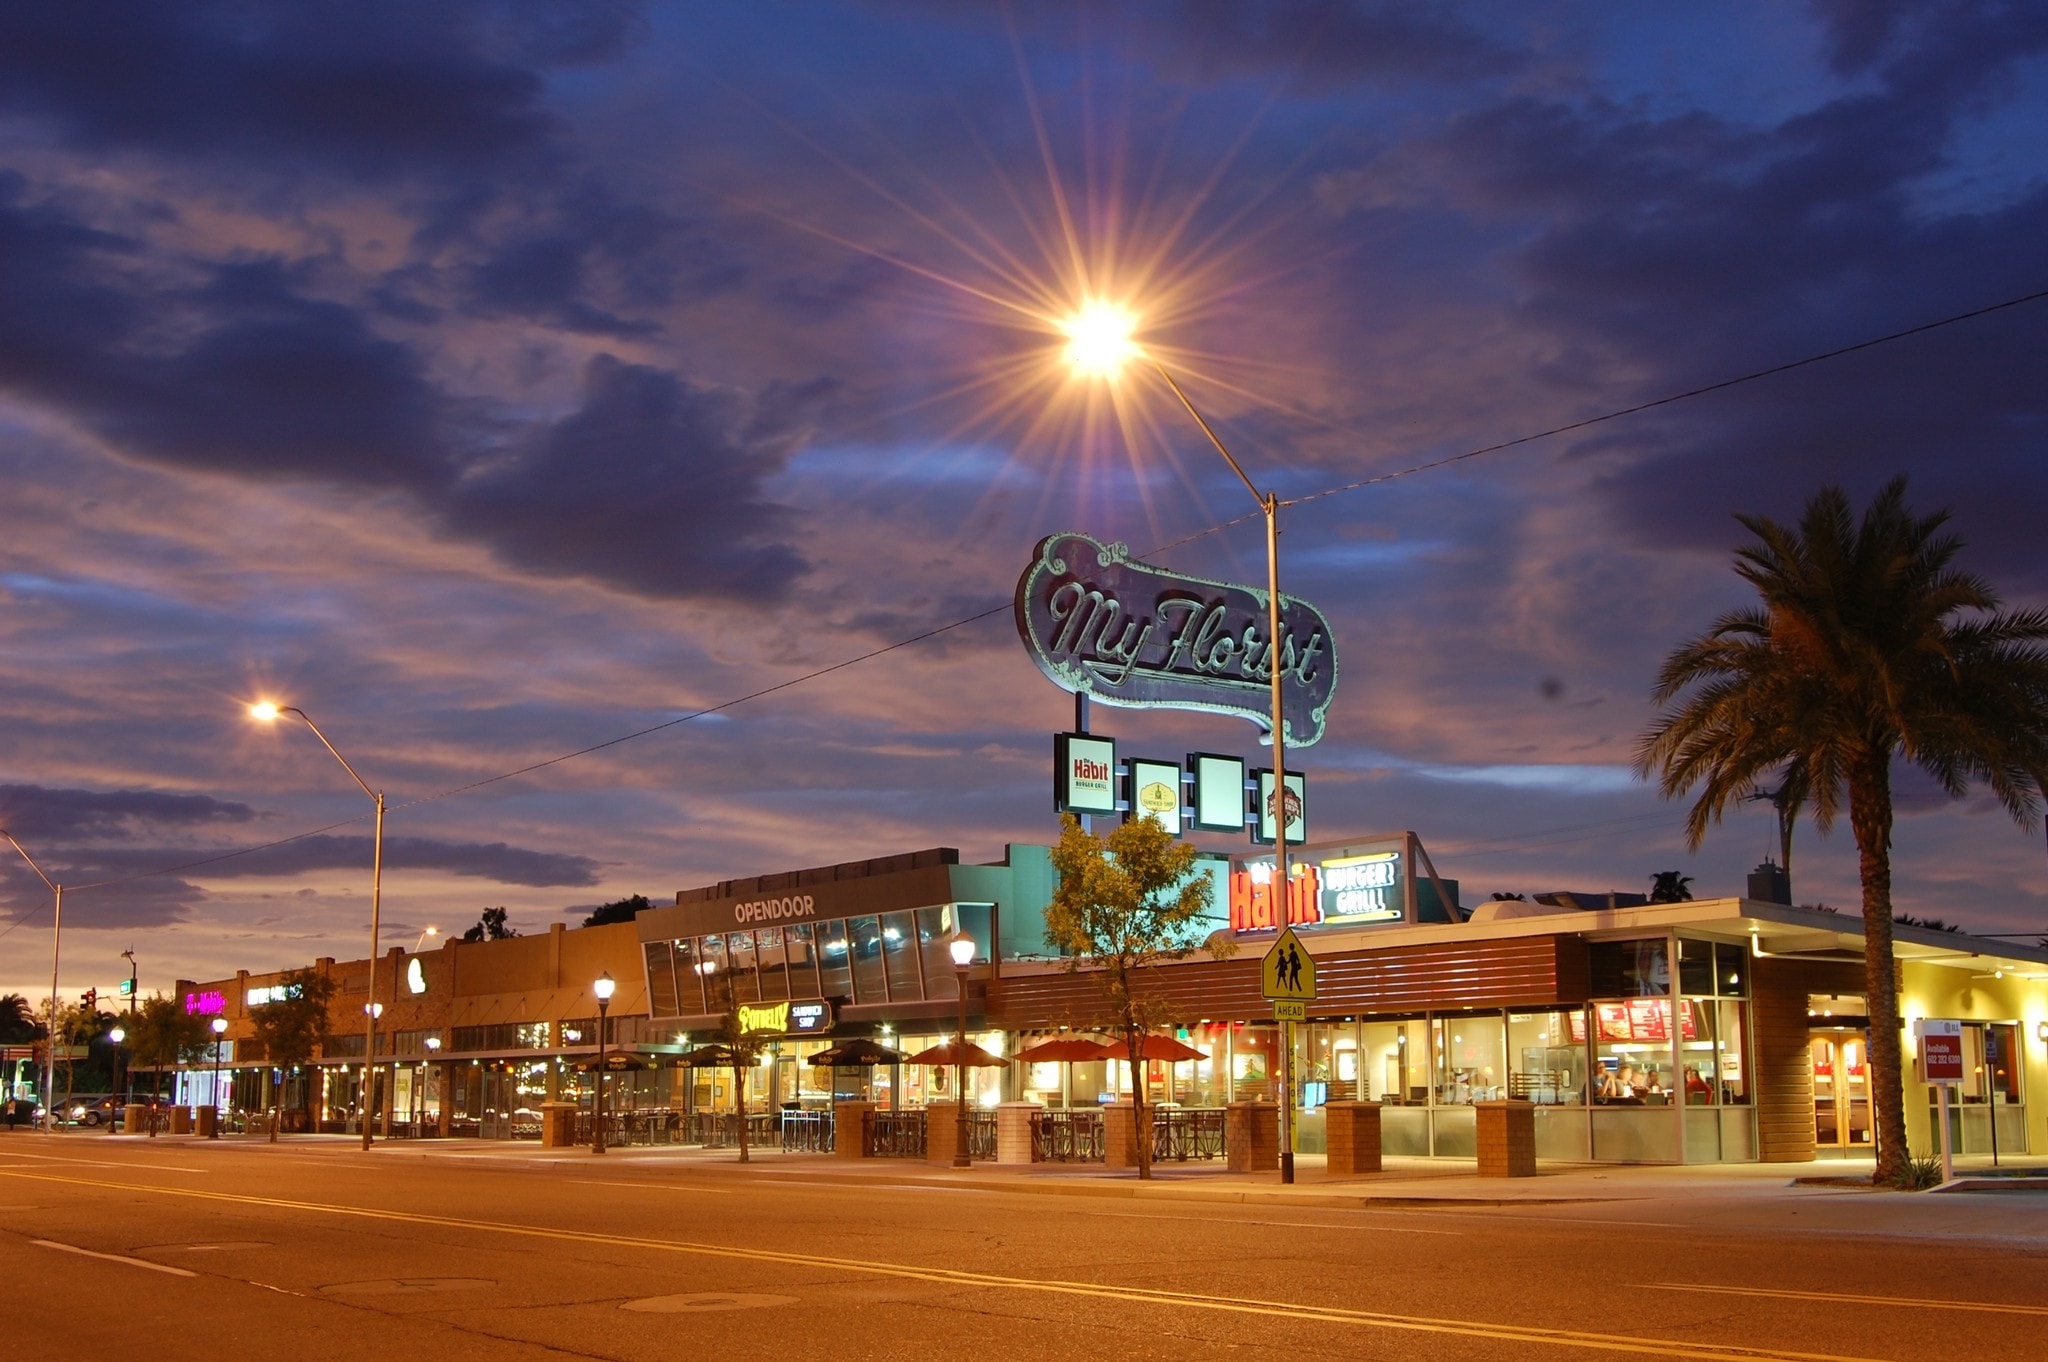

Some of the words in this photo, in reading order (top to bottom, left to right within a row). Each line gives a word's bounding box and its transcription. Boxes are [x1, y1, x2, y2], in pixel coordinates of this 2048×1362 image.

[1050, 582, 1153, 686] My
[1158, 598, 1322, 686] Florist
[1074, 759, 1108, 781] Habit
[1326, 862, 1391, 892] BURGER
[735, 895, 815, 923] OPENDOOR
[1231, 866, 1320, 931] Habit
[1336, 889, 1385, 913] GRILL
[1278, 1006, 1302, 1016] AHEAD
[1927, 1044, 1950, 1053] Available
